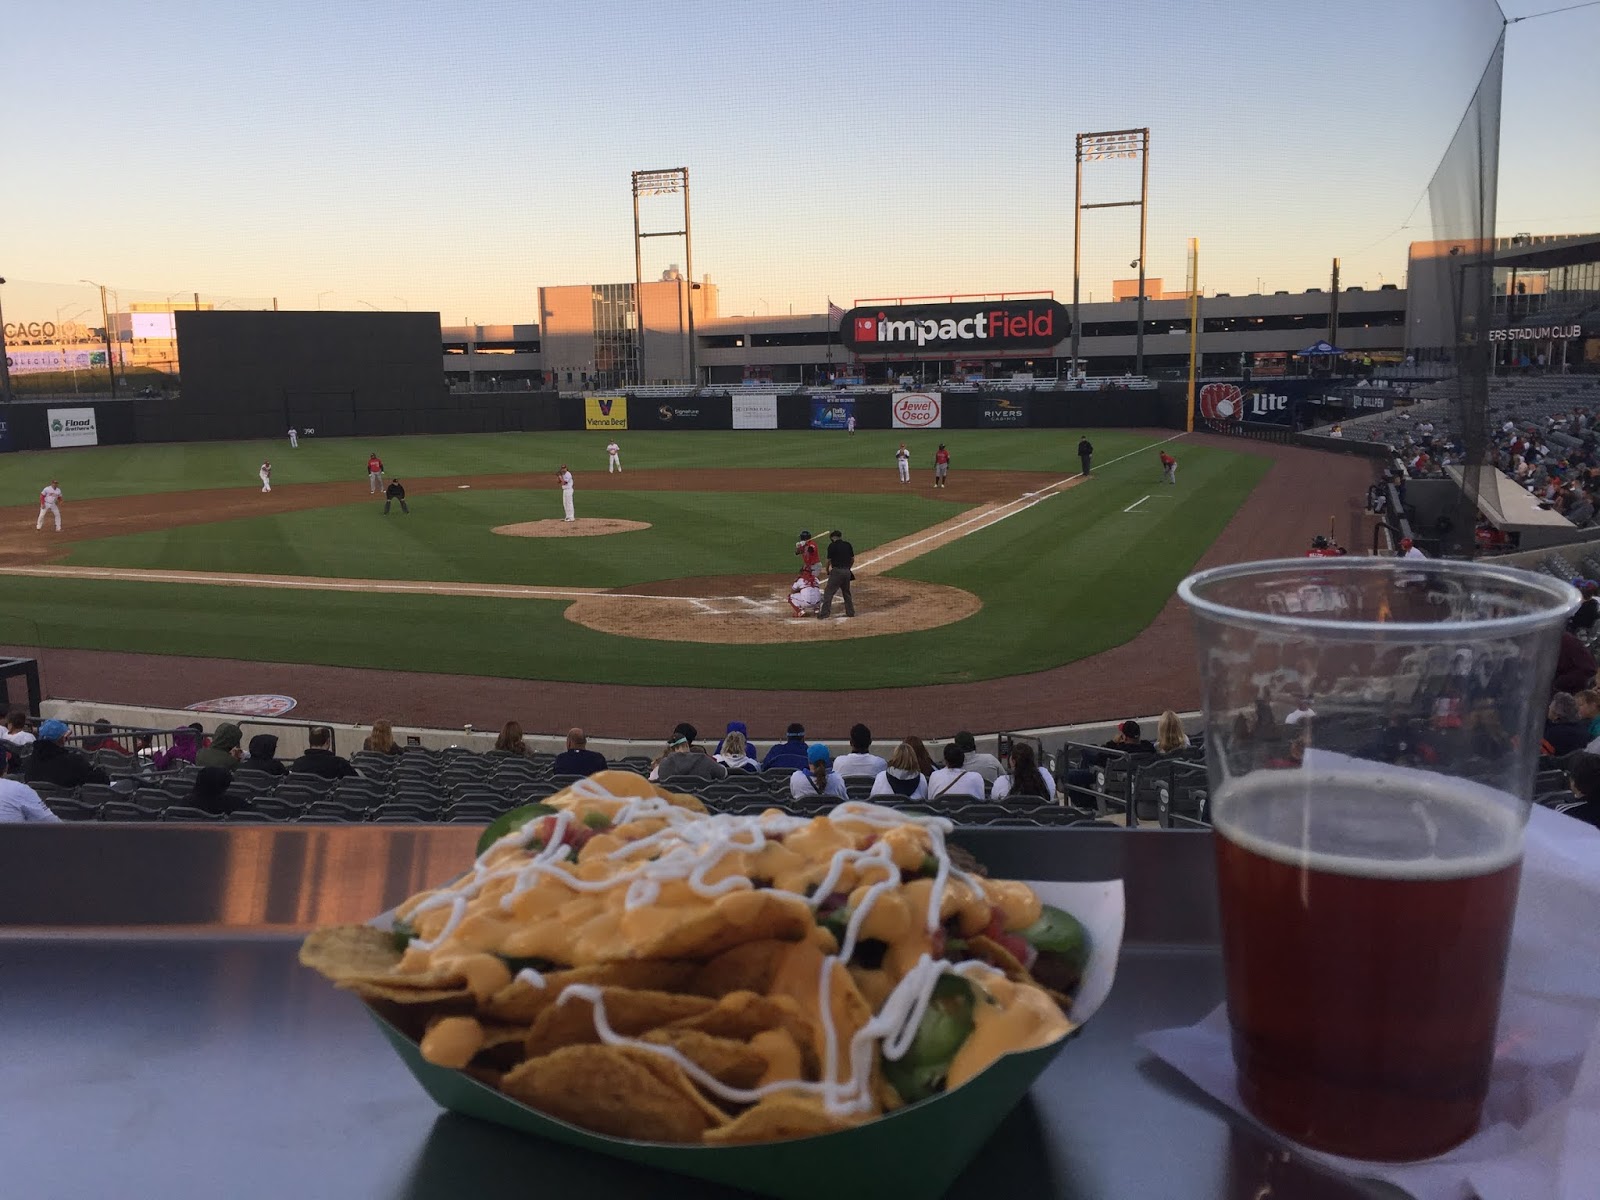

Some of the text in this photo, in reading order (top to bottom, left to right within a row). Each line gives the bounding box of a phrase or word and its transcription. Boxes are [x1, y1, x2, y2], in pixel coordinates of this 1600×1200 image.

[1508, 326, 1551, 340] STADIUM
[1552, 324, 1582, 339] CLUB
[900, 400, 932, 411] Jewel
[1251, 392, 1288, 415] Lite
[902, 410, 930, 421] Osco
[65, 418, 91, 427] Flood
[587, 417, 626, 427] Vienna Beef
